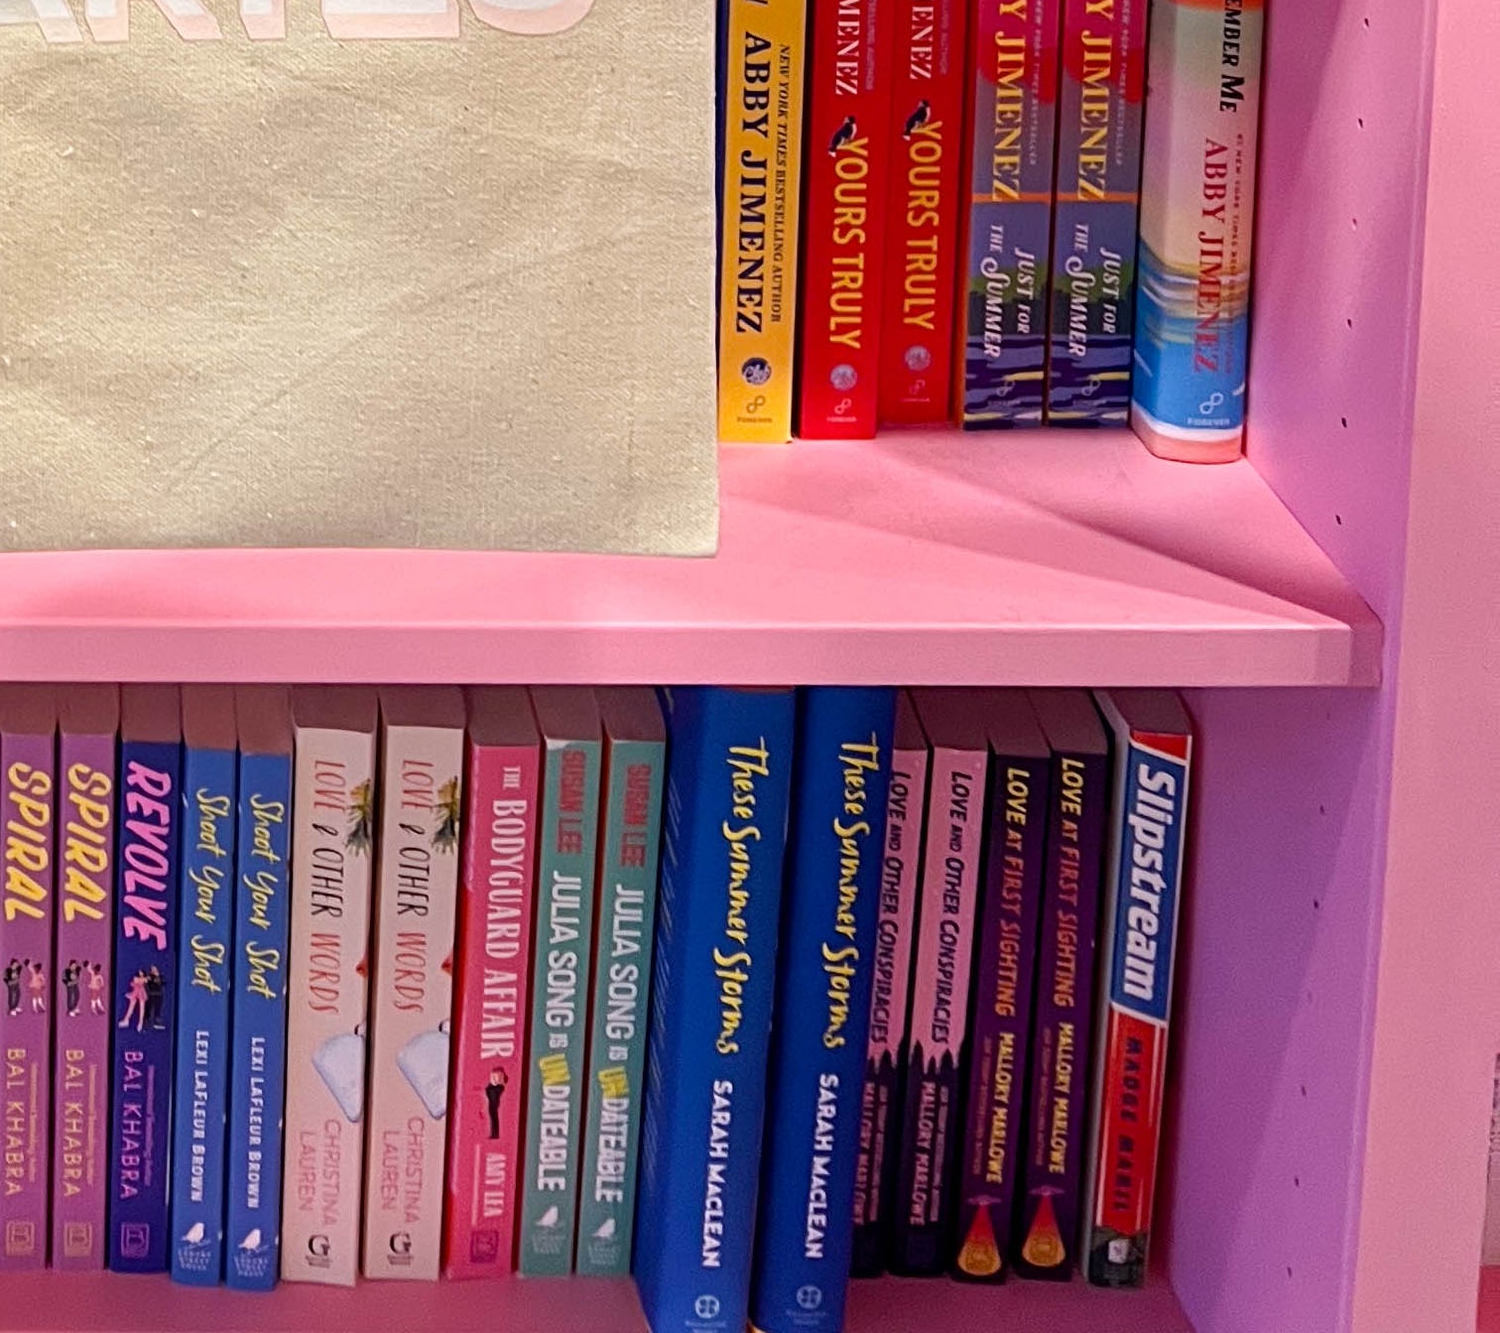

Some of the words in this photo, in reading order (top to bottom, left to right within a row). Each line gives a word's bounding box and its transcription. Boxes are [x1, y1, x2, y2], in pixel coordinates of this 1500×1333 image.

[743, 31, 772, 135] ABBY
[776, 79, 789, 116] YORK
[778, 44, 791, 74] NEW
[775, 120, 787, 165] TIMES
[772, 171, 786, 262] BESTSELLING
[830, 136, 869, 243] YOURS
[736, 146, 768, 334] JIMENEZ
[771, 268, 783, 323] AUTHOR
[828, 249, 866, 350] TRULY
[313, 760, 346, 815] LOVE
[728, 736, 770, 820] These
[1057, 757, 1084, 815] LOVE
[123, 761, 171, 952] REVOLVE
[310, 846, 345, 918] OTHER
[485, 799, 528, 960] BODYGUARD
[722, 821, 761, 943] Summer
[1055, 847, 1080, 906] FIRST
[1122, 762, 1177, 1002] Slipstream
[548, 872, 581, 944] JULIA
[309, 933, 341, 1015] WORDS
[545, 953, 577, 1028] SONG
[930, 917, 961, 1046] CONSPIRACIES
[1051, 909, 1079, 1008] SIGHTING
[479, 968, 518, 1060] AFFAIR
[713, 946, 751, 1056] Storms
[196, 1030, 210, 1066] LEXI
[193, 1071, 209, 1136] LAFLEUR
[706, 1079, 733, 1159] SARAH
[190, 1143, 206, 1202] BROWN
[322, 1117, 342, 1228] CHRISTINA
[701, 1167, 729, 1268] MACLEAN
